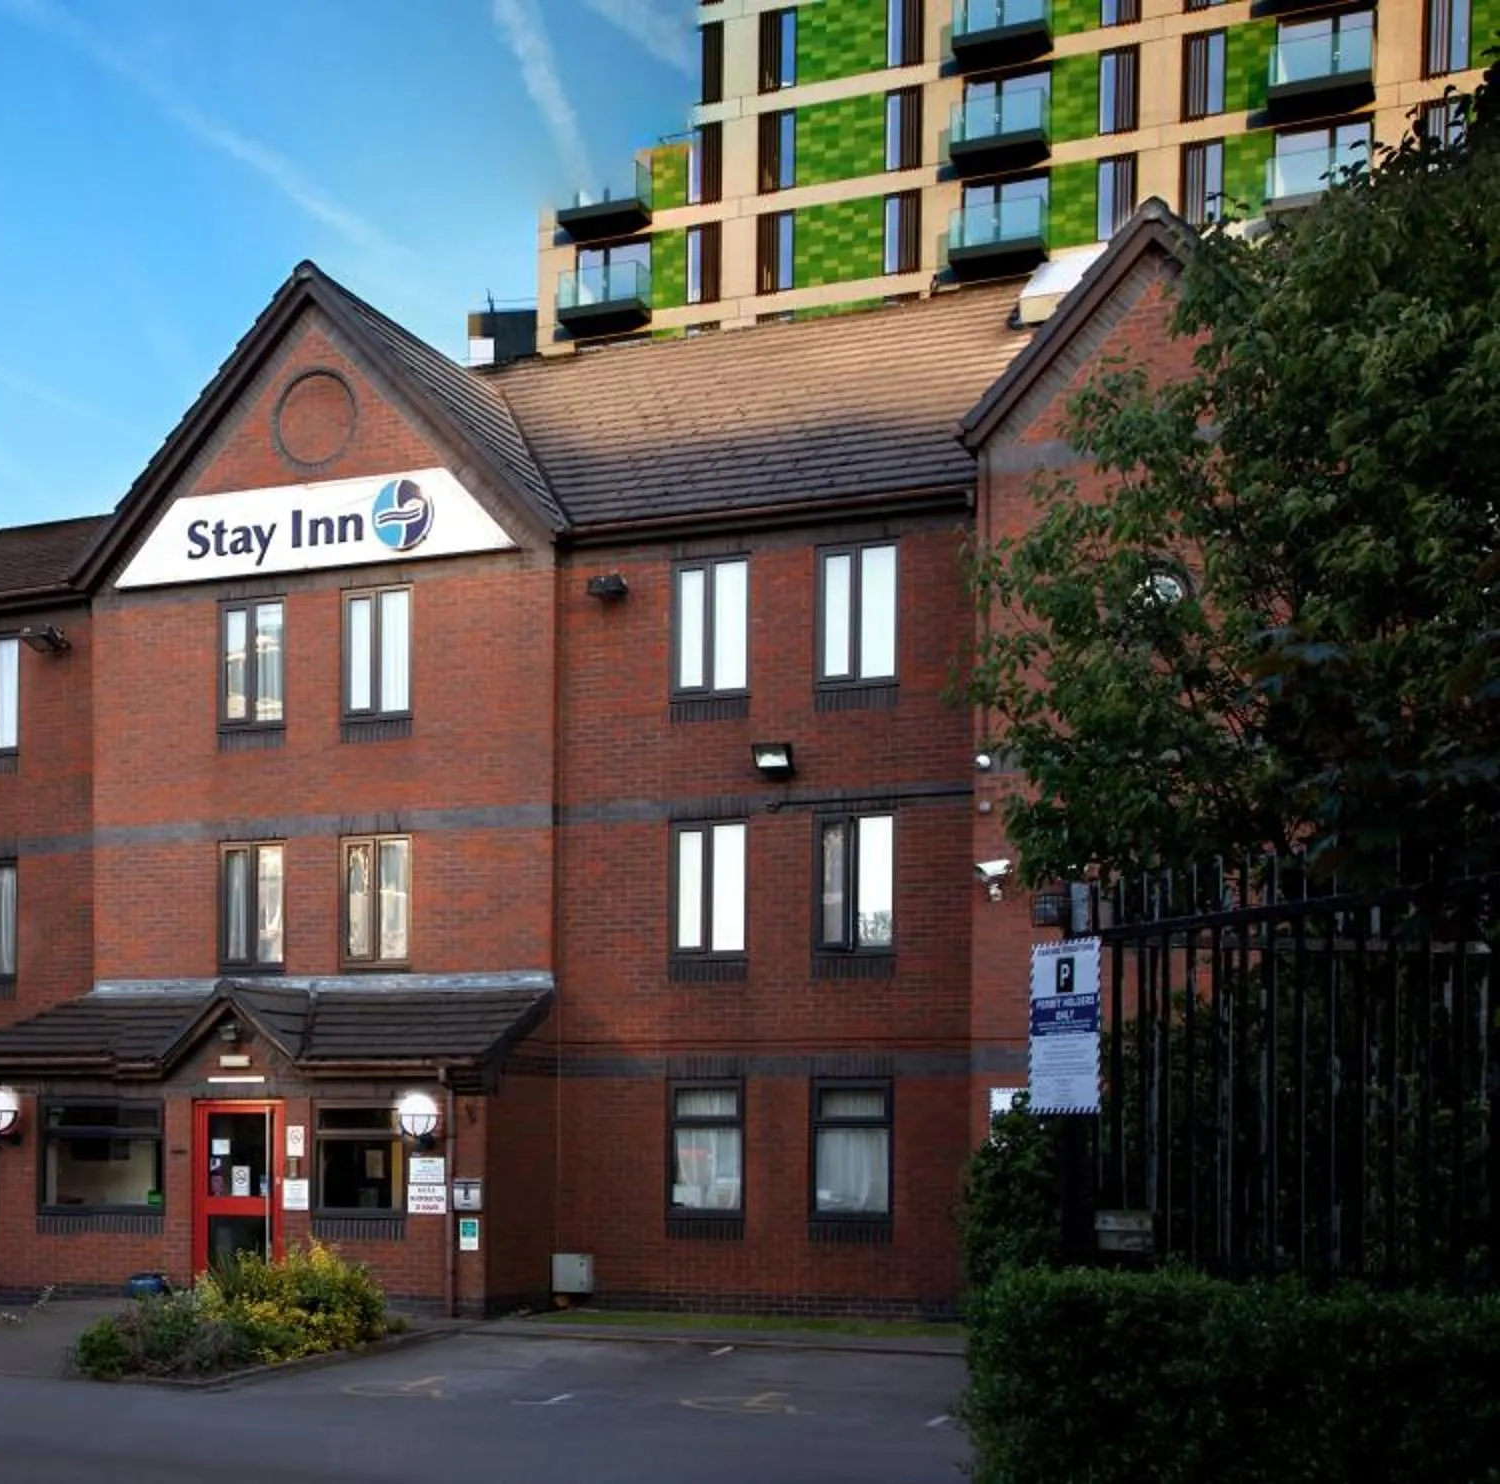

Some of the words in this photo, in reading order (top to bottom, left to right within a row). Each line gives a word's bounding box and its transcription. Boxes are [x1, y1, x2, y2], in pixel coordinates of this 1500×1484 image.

[187, 519, 277, 566] Stay
[291, 510, 364, 548] Inn
[1059, 963, 1071, 988] P
[1063, 996, 1095, 1008] HOLDERS
